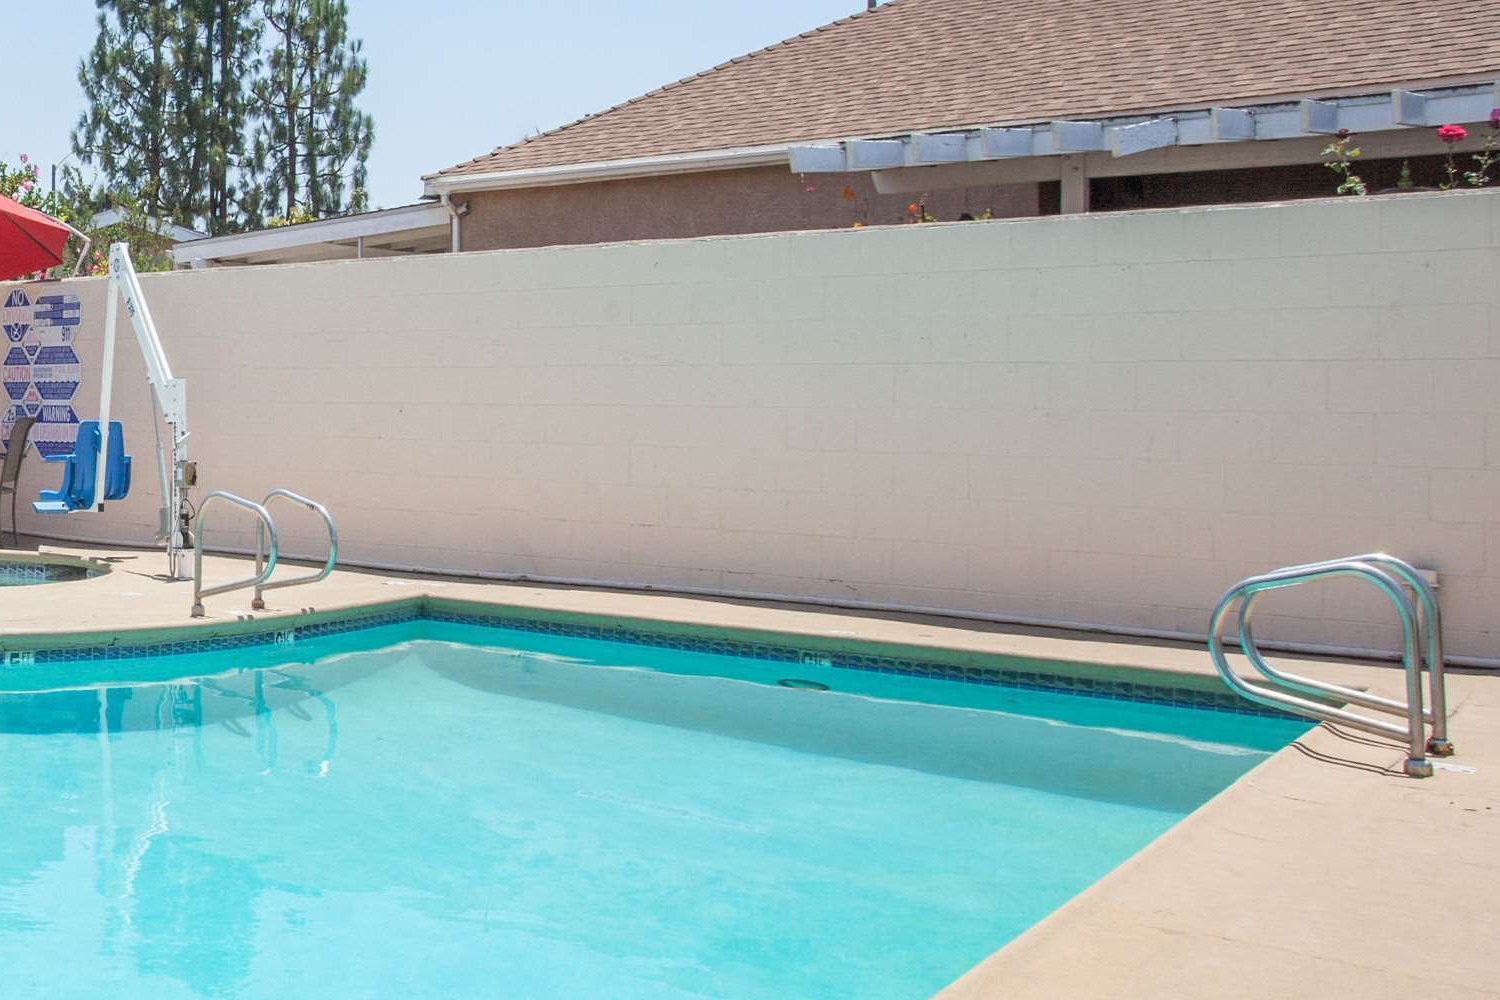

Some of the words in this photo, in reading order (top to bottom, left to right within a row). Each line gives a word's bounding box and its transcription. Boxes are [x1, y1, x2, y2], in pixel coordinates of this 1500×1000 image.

[11, 289, 25, 307] NO
[61, 326, 71, 342] 911
[2, 366, 31, 381] CAUTION
[42, 405, 71, 422] WARNING
